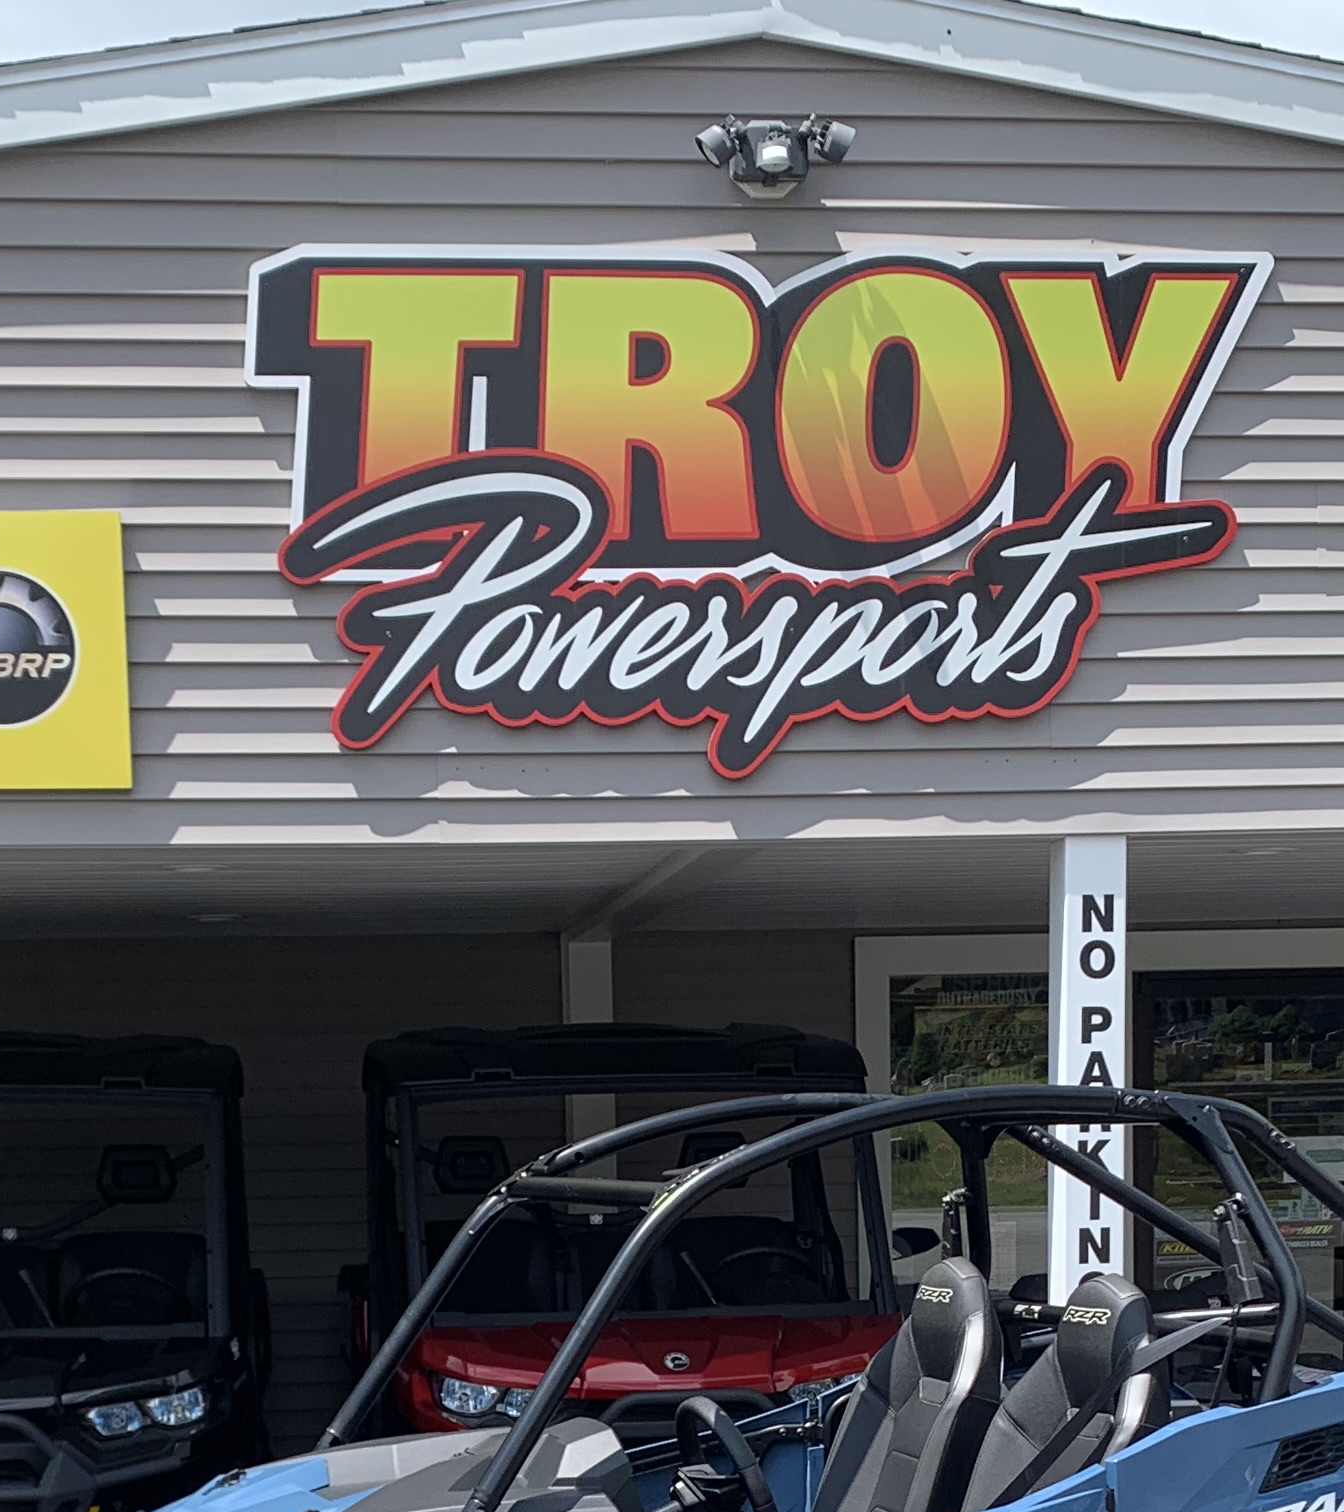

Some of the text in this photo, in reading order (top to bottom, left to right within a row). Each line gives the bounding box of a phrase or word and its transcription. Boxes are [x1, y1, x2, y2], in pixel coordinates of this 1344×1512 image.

[311, 267, 1238, 541] TROY
[313, 472, 1213, 743] Powersports
[1078, 894, 1116, 1288] NO PAKIN
[916, 1285, 954, 1303] RZR
[1062, 1305, 1111, 1325] RZR
